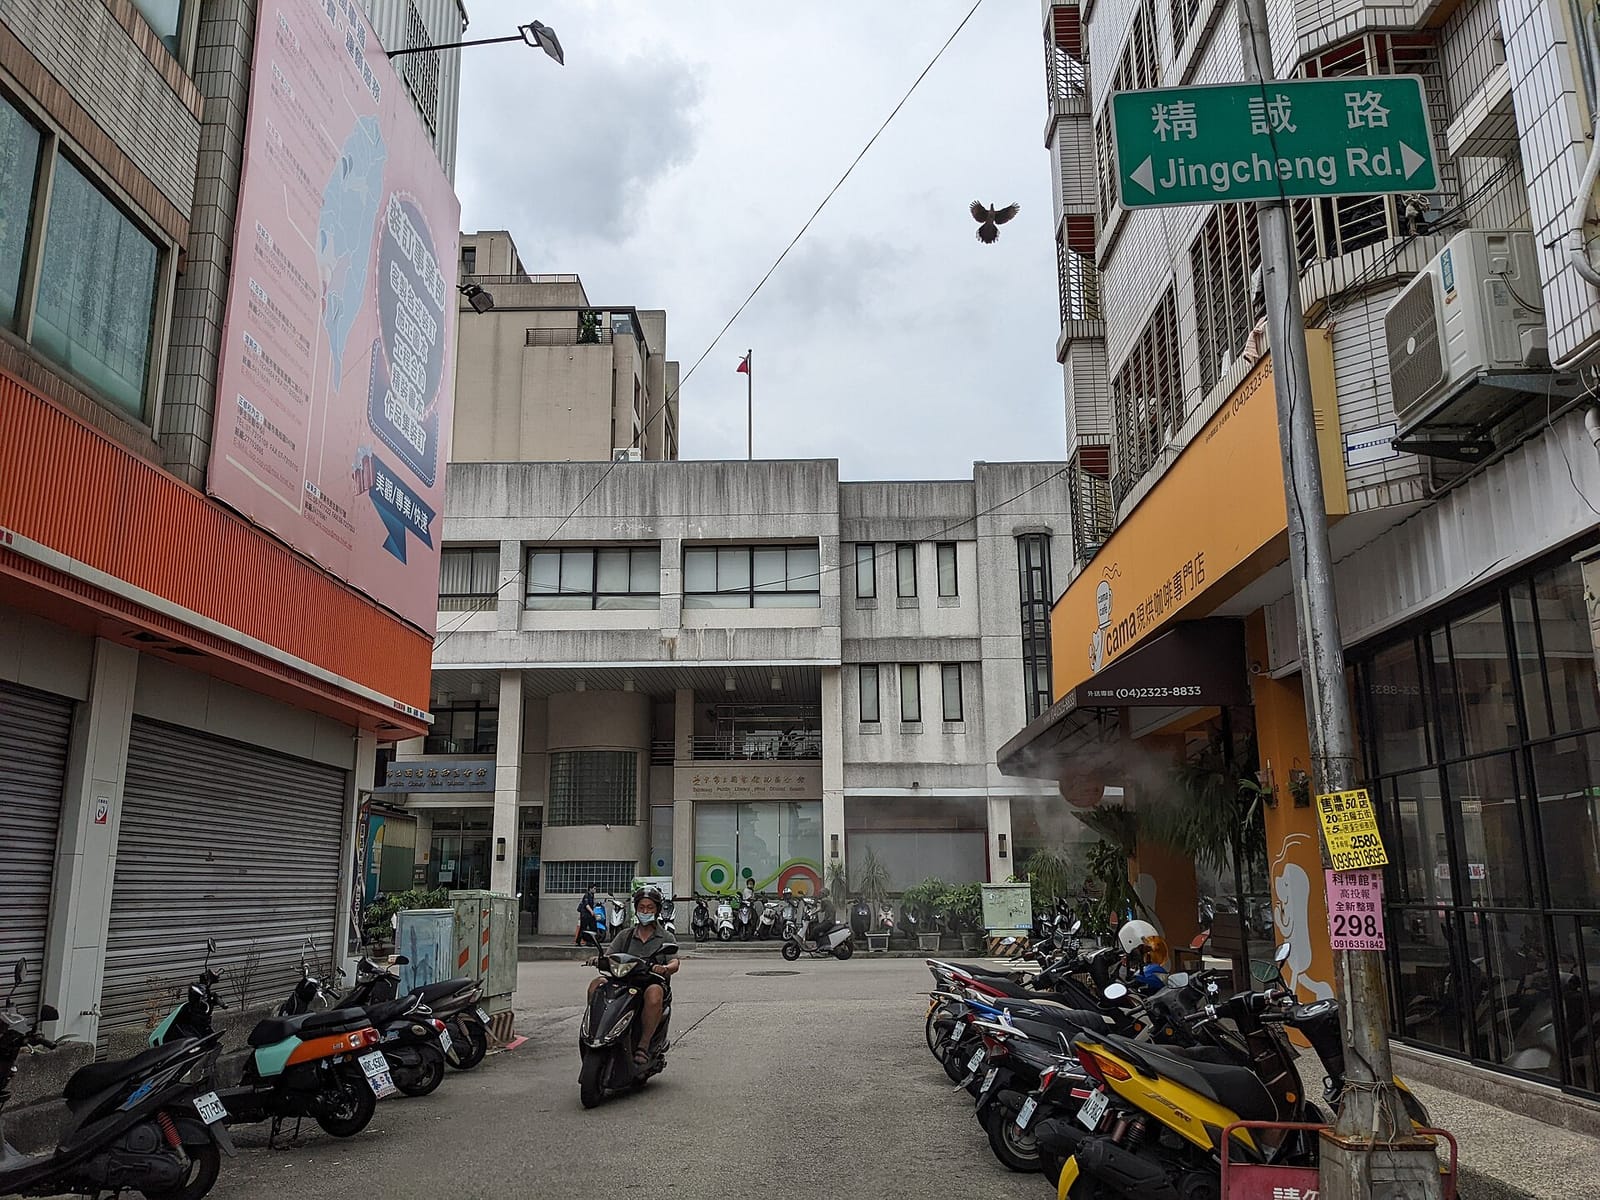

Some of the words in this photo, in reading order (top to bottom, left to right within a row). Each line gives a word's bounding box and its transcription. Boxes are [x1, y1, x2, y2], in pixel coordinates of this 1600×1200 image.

[1151, 90, 1390, 142] 精誠路
[1159, 152, 1338, 192] Jingcheng
[1346, 148, 1402, 177] Rd.
[375, 470, 428, 534] 美觀/專業/快速
[1106, 612, 1137, 657] cama
[1136, 551, 1205, 632] 現烘咖啡專門店
[1116, 686, 1202, 699] (04)2323-8833
[1346, 798, 1356, 810] 50
[1326, 814, 1338, 824] 20
[1350, 834, 1378, 850] 2580
[1332, 874, 1370, 886] 科博館
[1340, 888, 1370, 899] 高投報
[1336, 902, 1375, 912] 全新整理
[1334, 914, 1376, 937] 298
[1334, 940, 1384, 948] 0916351842
